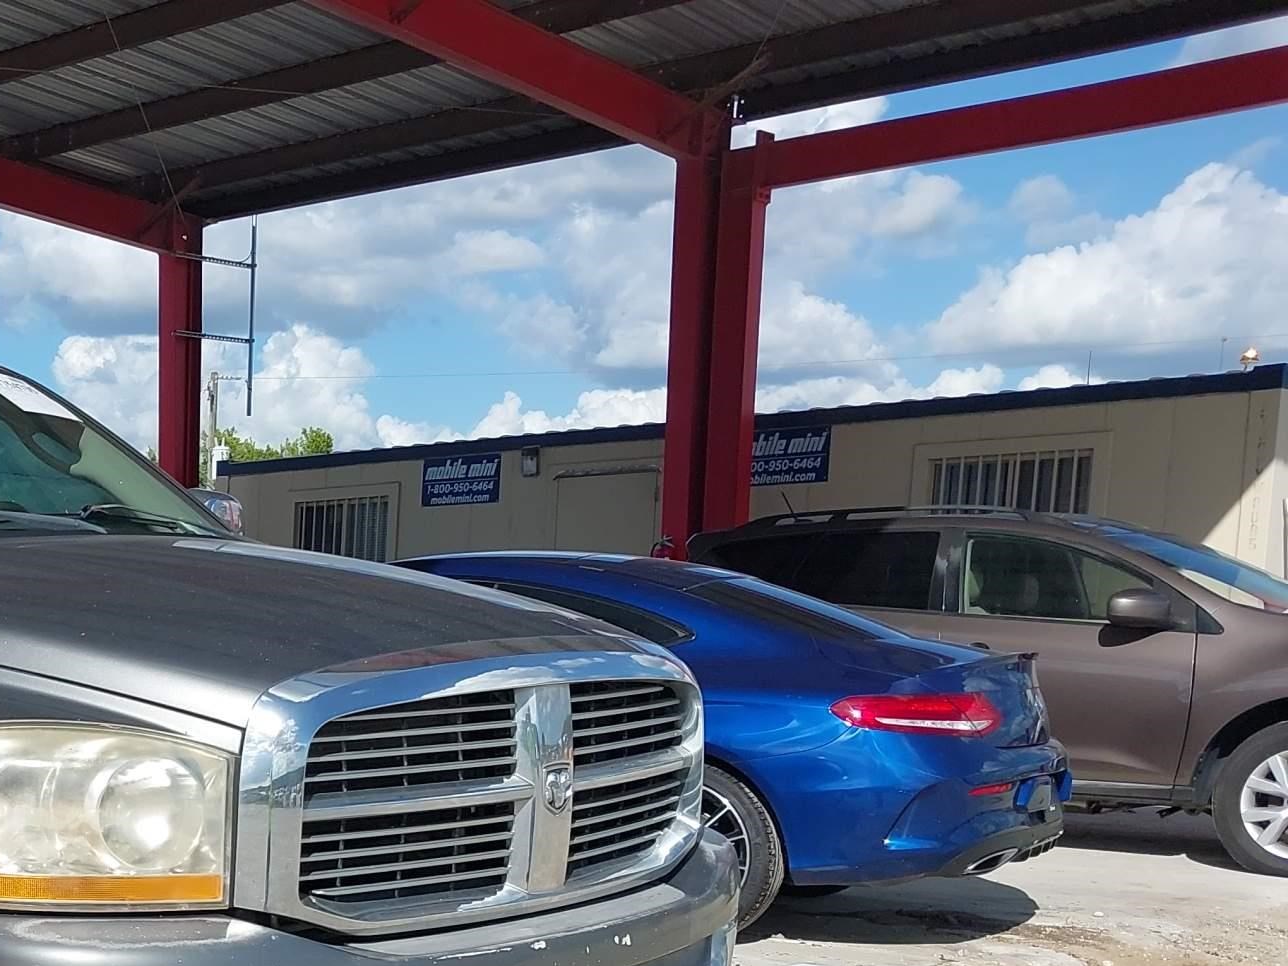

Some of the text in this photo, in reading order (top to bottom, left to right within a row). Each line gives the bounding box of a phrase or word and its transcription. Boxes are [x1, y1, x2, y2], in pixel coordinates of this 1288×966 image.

[787, 432, 828, 454] mini
[425, 458, 499, 481] mobile mini
[751, 457, 821, 472] 00-950-6464
[427, 481, 494, 494] 1-800-950-6464
[430, 494, 490, 505] mobilemini.com
